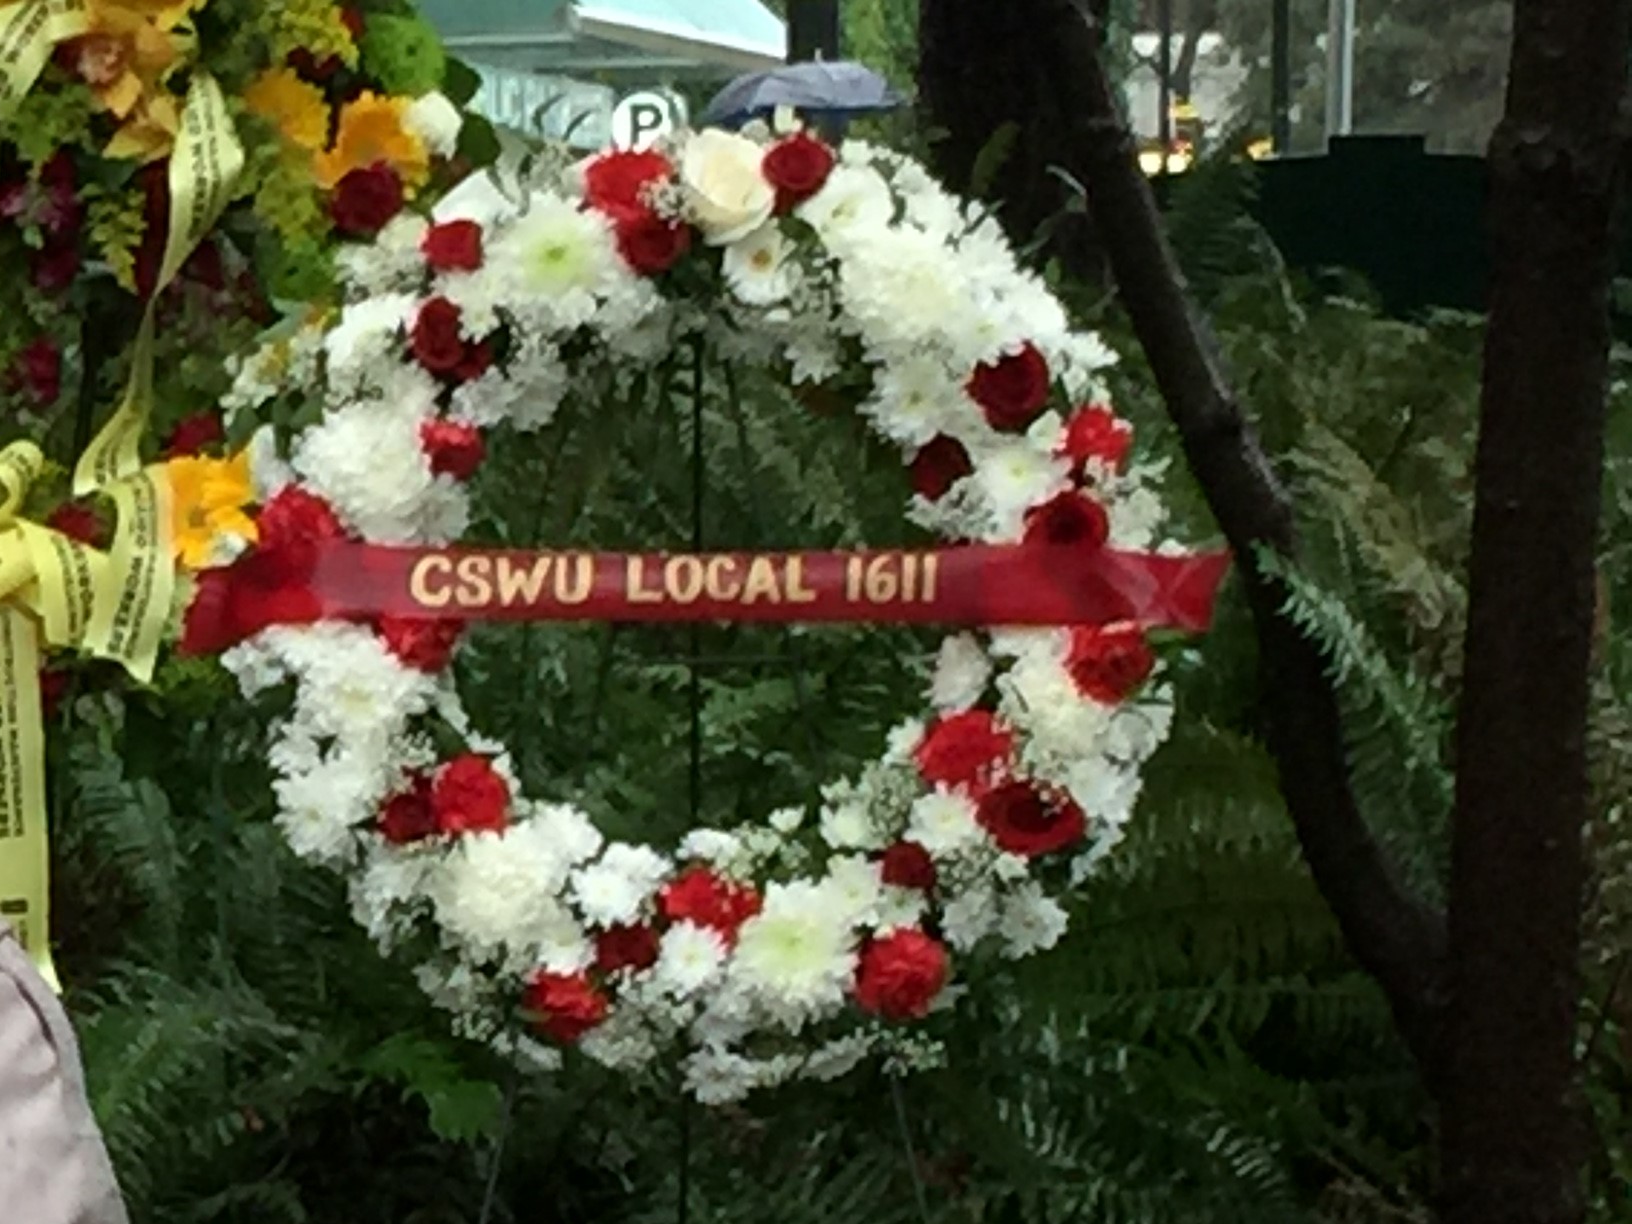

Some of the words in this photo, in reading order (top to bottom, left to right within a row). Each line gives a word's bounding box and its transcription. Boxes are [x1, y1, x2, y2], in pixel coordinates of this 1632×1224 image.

[629, 102, 663, 146] P
[410, 553, 593, 607] CSWU
[626, 553, 816, 605] LOCAL
[846, 553, 938, 604] 1611
